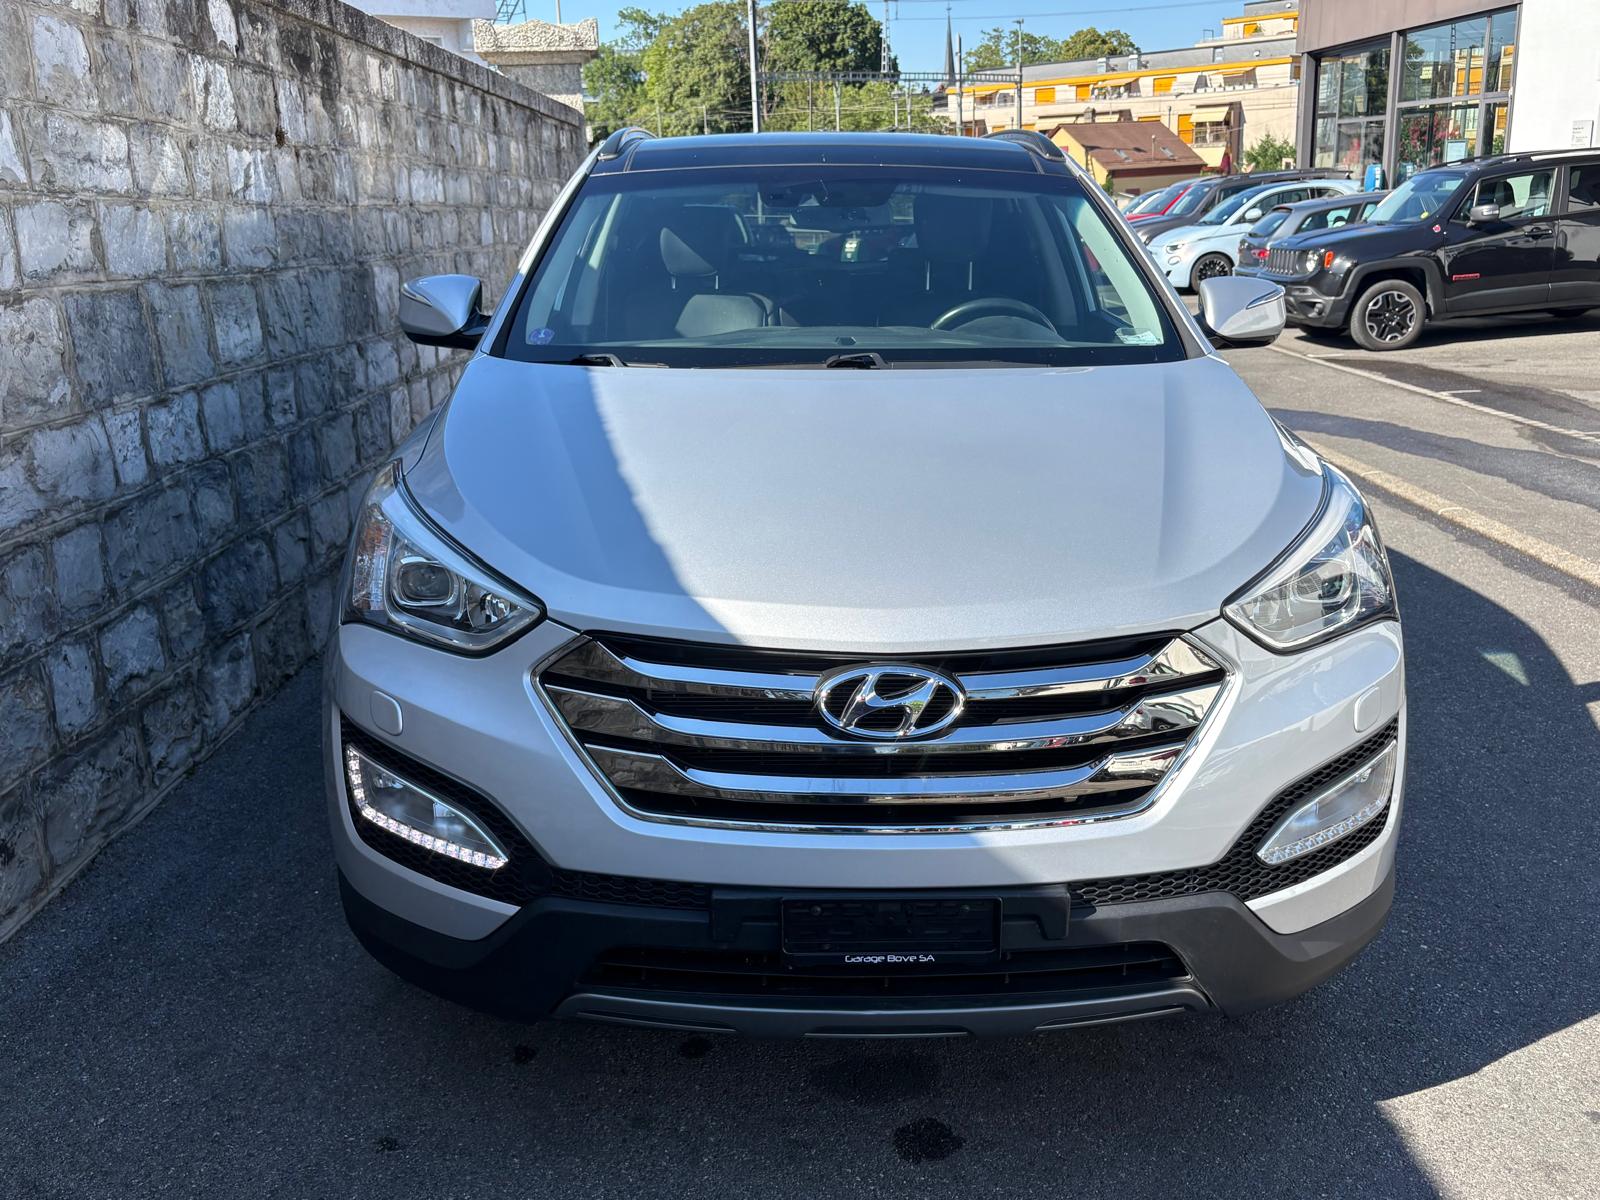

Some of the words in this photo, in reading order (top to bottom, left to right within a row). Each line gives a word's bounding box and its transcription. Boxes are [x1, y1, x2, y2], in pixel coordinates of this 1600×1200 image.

[844, 955, 885, 964] Garage
[887, 954, 917, 962] Bove
[918, 954, 935, 962] SA
